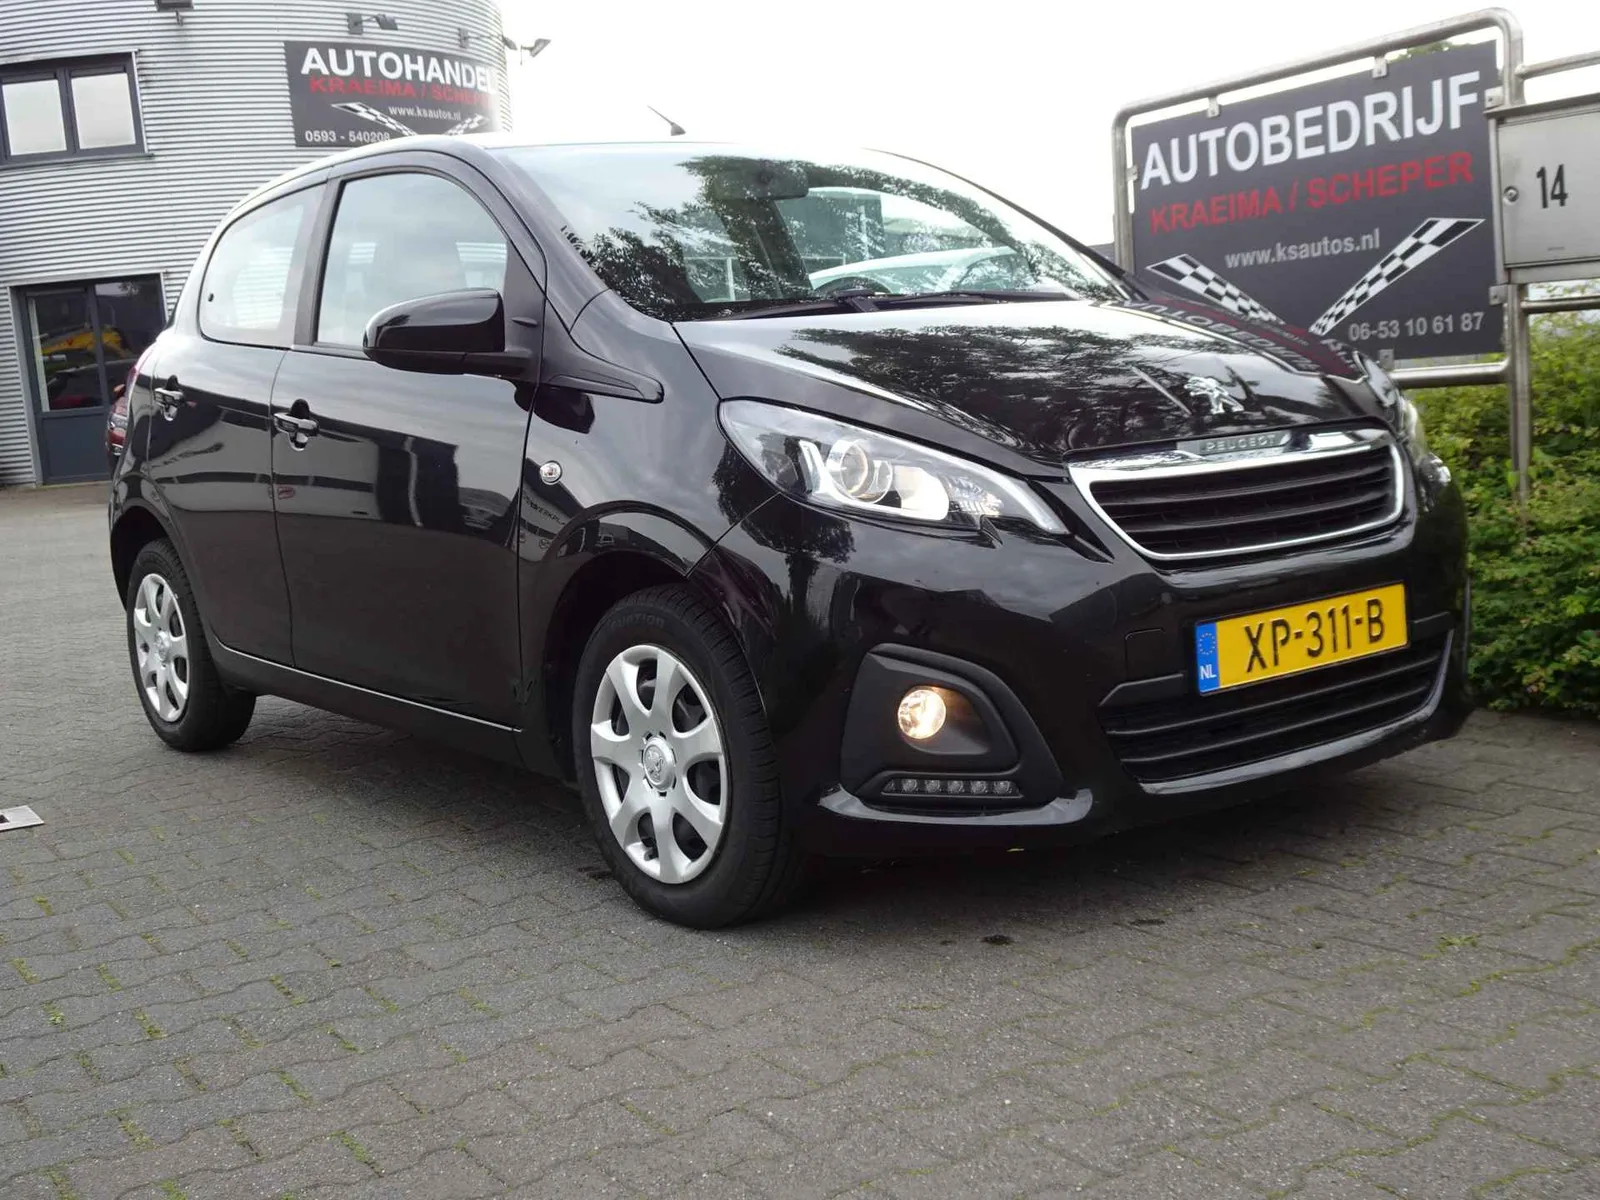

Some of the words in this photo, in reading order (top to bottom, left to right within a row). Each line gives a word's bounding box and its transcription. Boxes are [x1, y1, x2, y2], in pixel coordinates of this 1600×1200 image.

[301, 47, 496, 94] AUTOHANDEL
[309, 76, 415, 97] KRAEIMA
[387, 105, 461, 121] www.ksautos.nl
[1140, 71, 1481, 190] AUTOBEDRIJF
[304, 129, 336, 142] 0593
[348, 131, 390, 143] 540208
[1150, 187, 1282, 236] KRAEIMA
[1289, 180, 1299, 212] /
[1306, 150, 1474, 210] SCHEPER
[1536, 163, 1568, 209] 14
[1225, 227, 1381, 269] www.ksautos.nl
[1348, 314, 1400, 341] 06-53
[1405, 316, 1428, 337] 10
[1432, 314, 1455, 334] 61
[1460, 311, 1484, 333] 87
[1206, 434, 1276, 452] PEUGEOT
[1244, 598, 1385, 673] XP-311-B
[1200, 664, 1216, 680] NL
